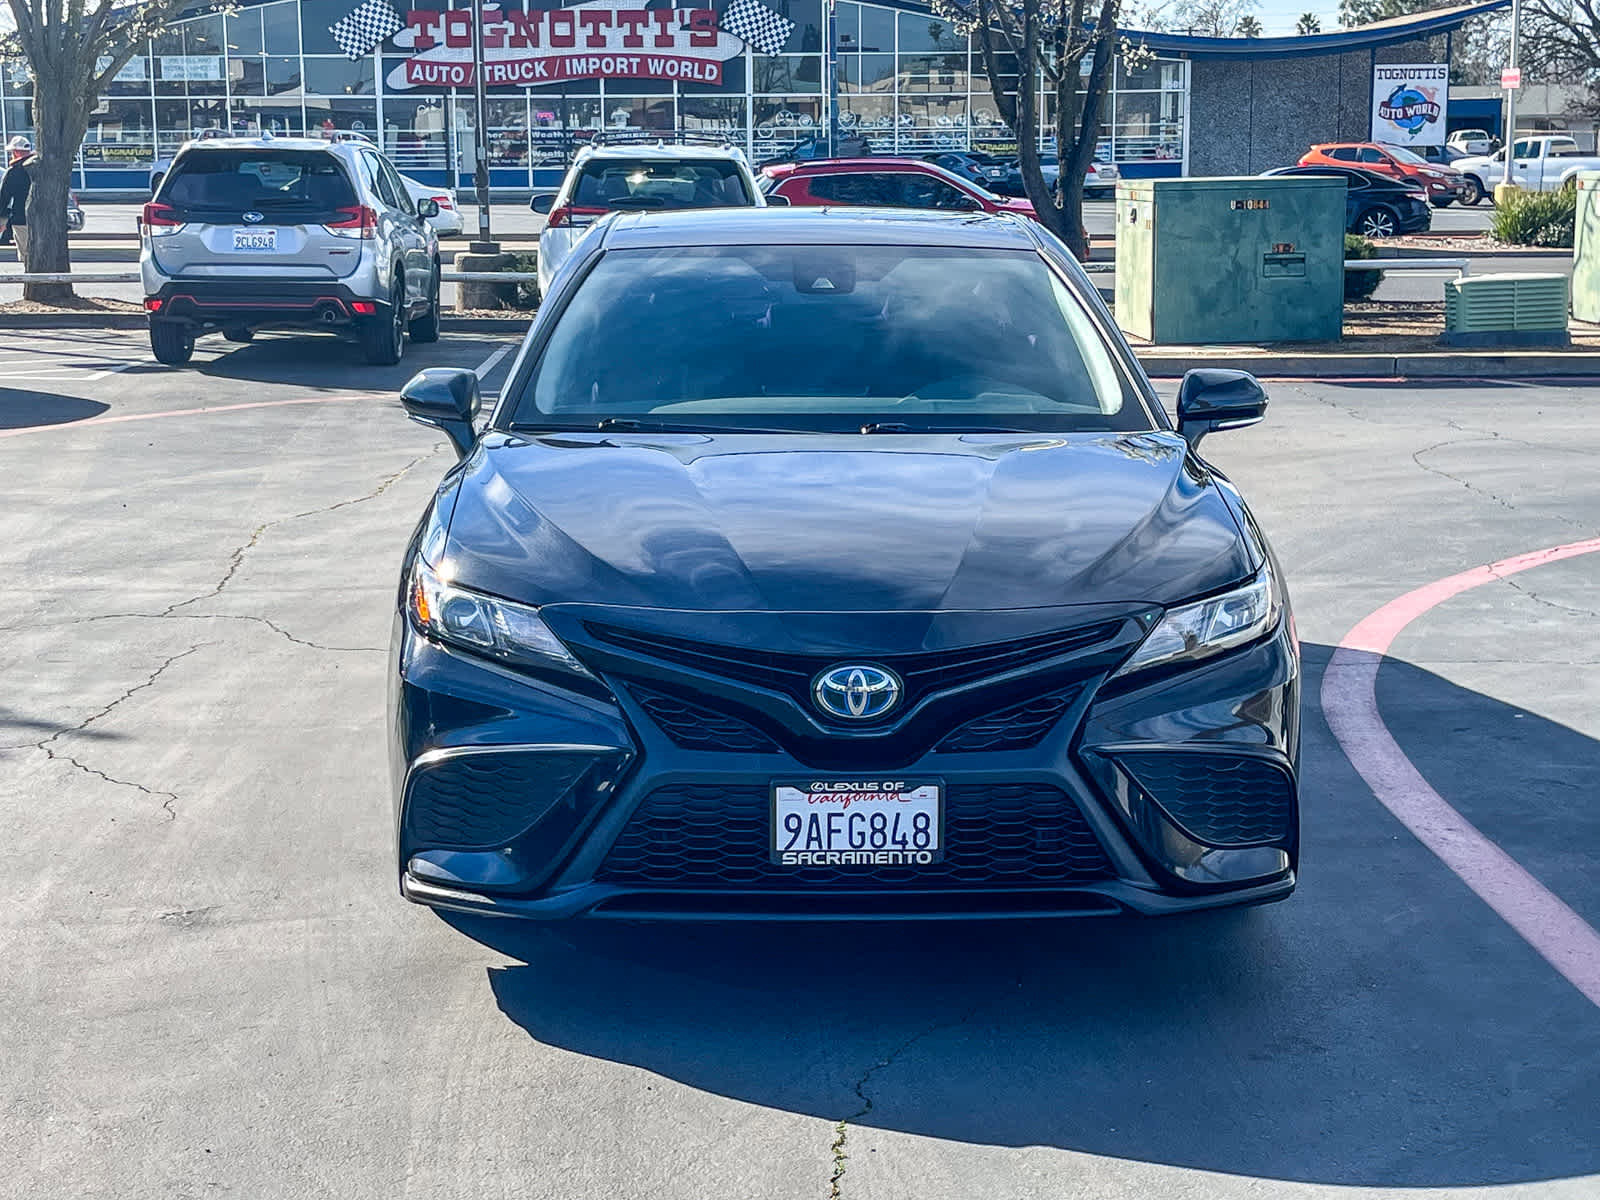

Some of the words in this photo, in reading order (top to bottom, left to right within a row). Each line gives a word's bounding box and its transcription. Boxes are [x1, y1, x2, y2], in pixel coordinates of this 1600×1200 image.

[407, 9, 718, 48] TOGNOTTI'S
[411, 63, 465, 84] AUTO
[484, 60, 548, 82] TRUCK
[565, 57, 640, 76] IMPORT
[647, 58, 718, 81] WORLD
[824, 782, 879, 791] LEXUS
[883, 782, 905, 791] OF
[784, 812, 931, 850] 9AFG848
[782, 851, 932, 865] SACRAMENTO
